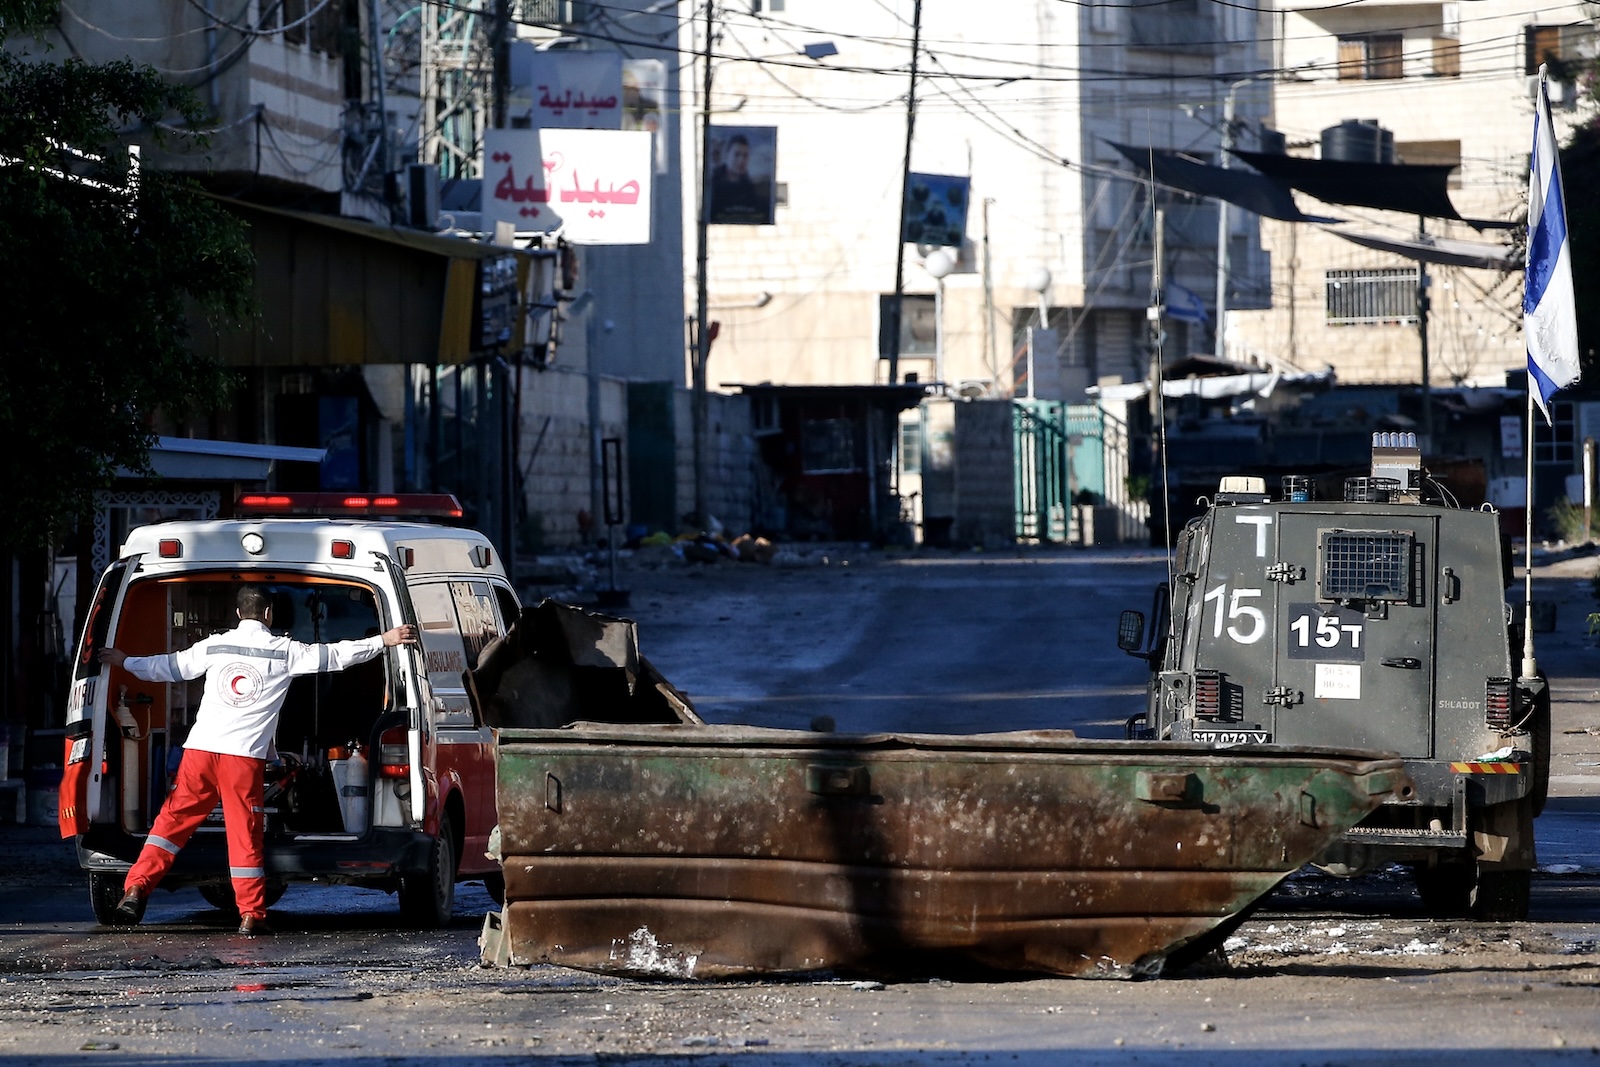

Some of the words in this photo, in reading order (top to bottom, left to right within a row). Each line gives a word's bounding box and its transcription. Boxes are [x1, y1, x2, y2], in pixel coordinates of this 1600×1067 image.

[538, 85, 618, 115] صيدلية
[491, 151, 640, 219] صيدلية
[1235, 515, 1273, 557] T
[1204, 583, 1266, 645] 15
[1438, 700, 1481, 709] SHLADOT
